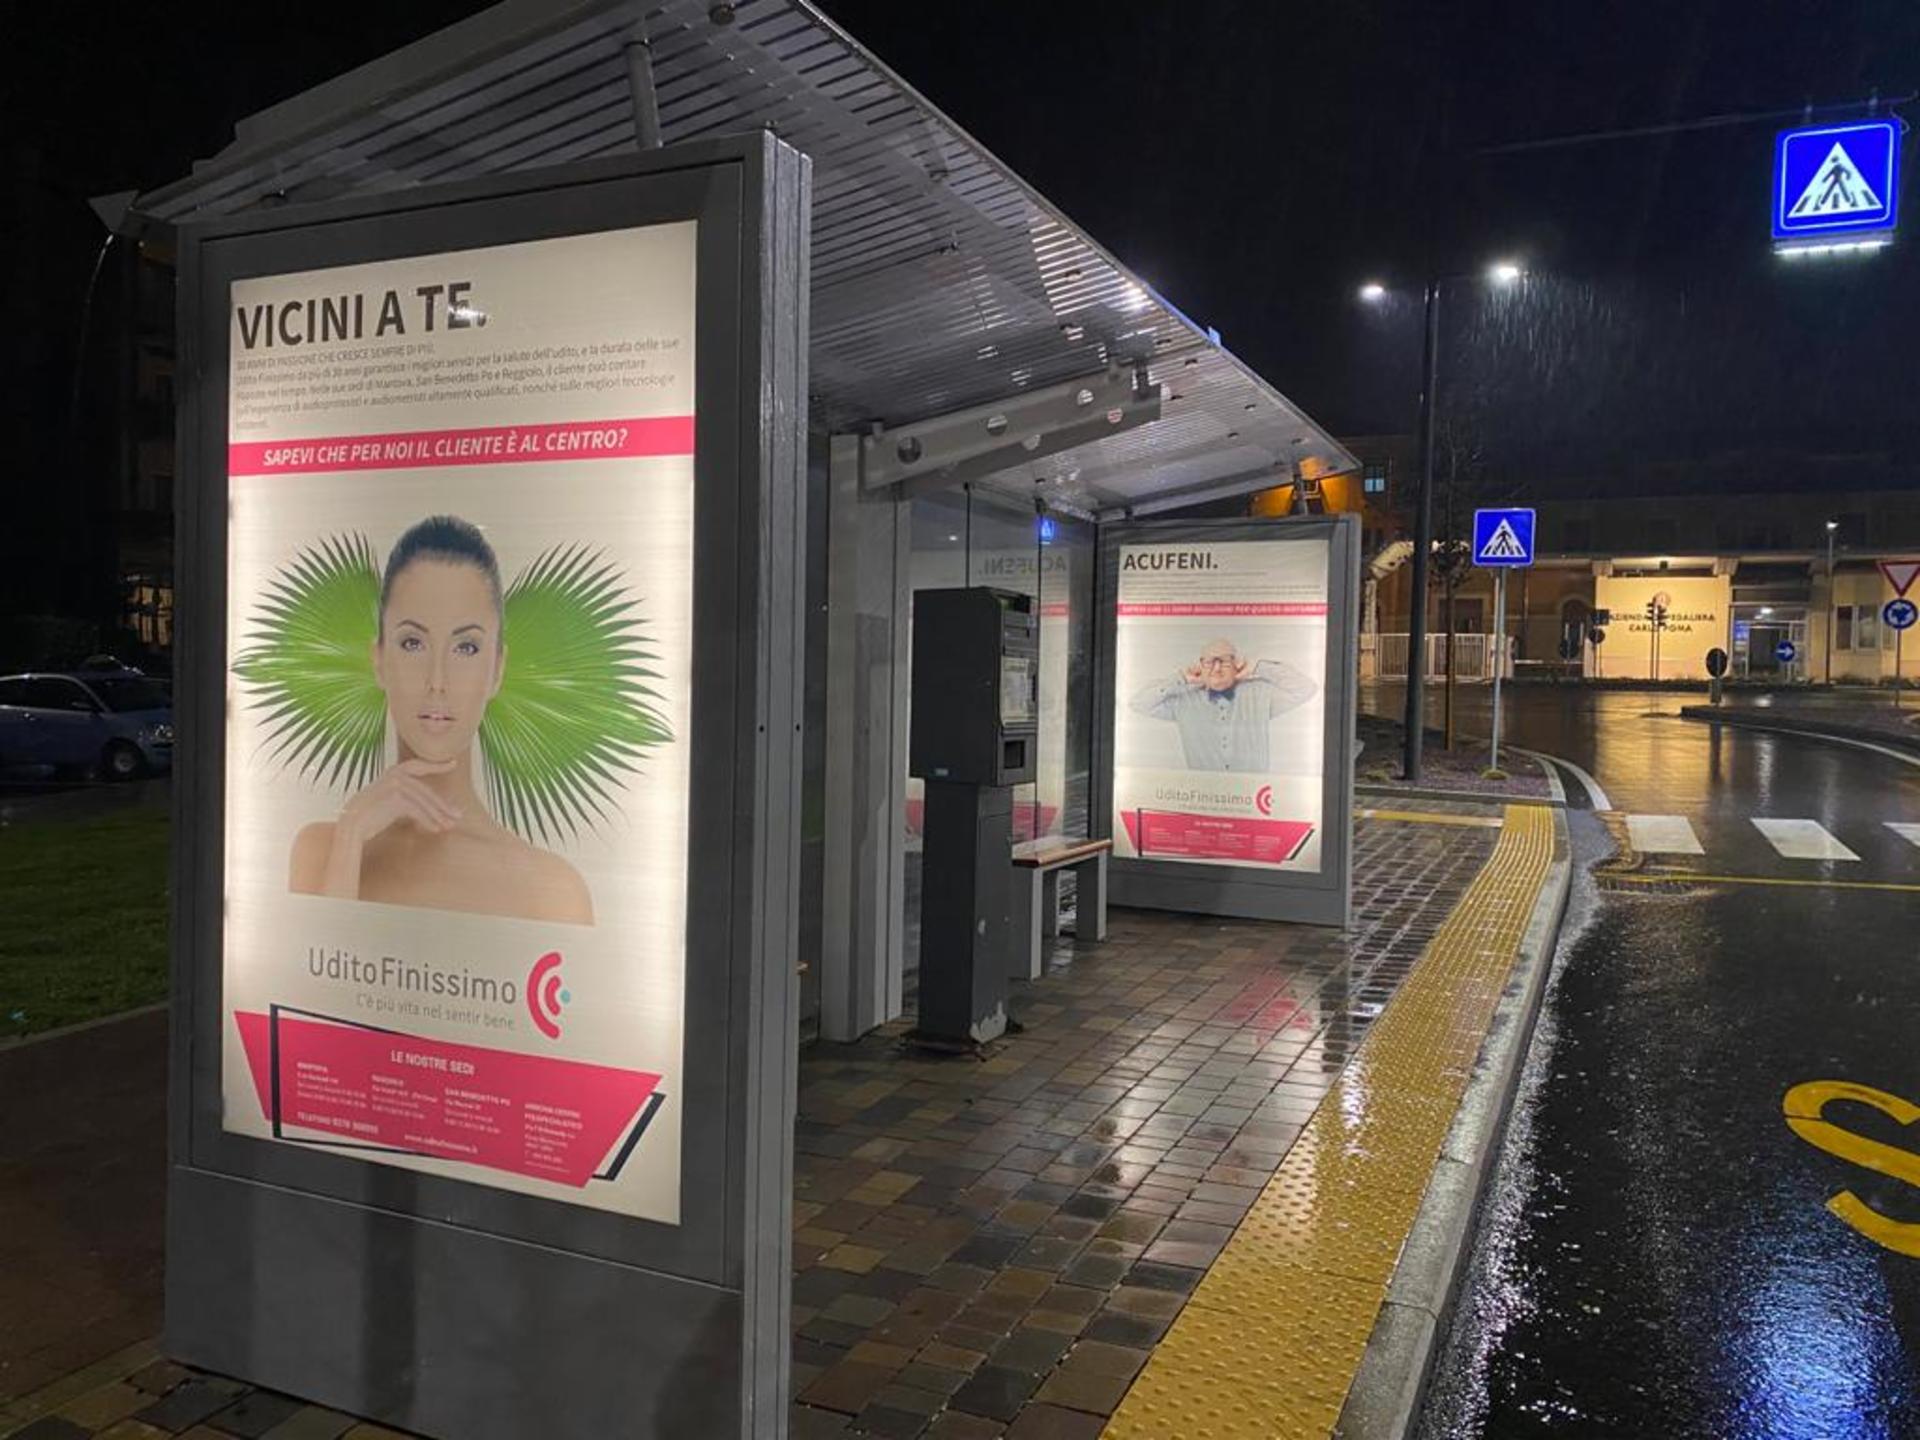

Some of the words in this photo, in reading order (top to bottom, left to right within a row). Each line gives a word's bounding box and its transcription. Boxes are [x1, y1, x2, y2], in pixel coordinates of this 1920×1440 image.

[237, 294, 363, 349] VICINI
[376, 290, 405, 337] A
[416, 282, 487, 332] TE.
[336, 348, 368, 362] CRESCE
[476, 355, 491, 368] per
[493, 352, 501, 363] la
[502, 351, 530, 363] salute
[601, 341, 632, 355] durata
[634, 339, 659, 351] delle
[661, 338, 680, 349] sue
[553, 362, 585, 376] cliente
[608, 357, 646, 371] contare
[263, 447, 314, 467] SAPEVI
[317, 445, 347, 464] CHE
[350, 443, 382, 463] PER
[383, 441, 413, 460] NOI
[415, 439, 430, 458] IL
[434, 435, 502, 458] CLIENTE
[506, 430, 518, 453] È
[519, 433, 541, 452] AL
[545, 428, 628, 451] CENTRO?
[1123, 552, 1218, 570] ACUFENI.
[308, 947, 517, 1004] UditoFinissimo
[356, 993, 374, 1009] C'è
[376, 996, 394, 1014] più
[400, 999, 420, 1016] vita
[422, 1003, 442, 1020] nel
[446, 1007, 480, 1025] sentir
[391, 1049, 404, 1064] LE
[405, 1052, 447, 1072] NOSTRE
[450, 1060, 475, 1076] SEDI
